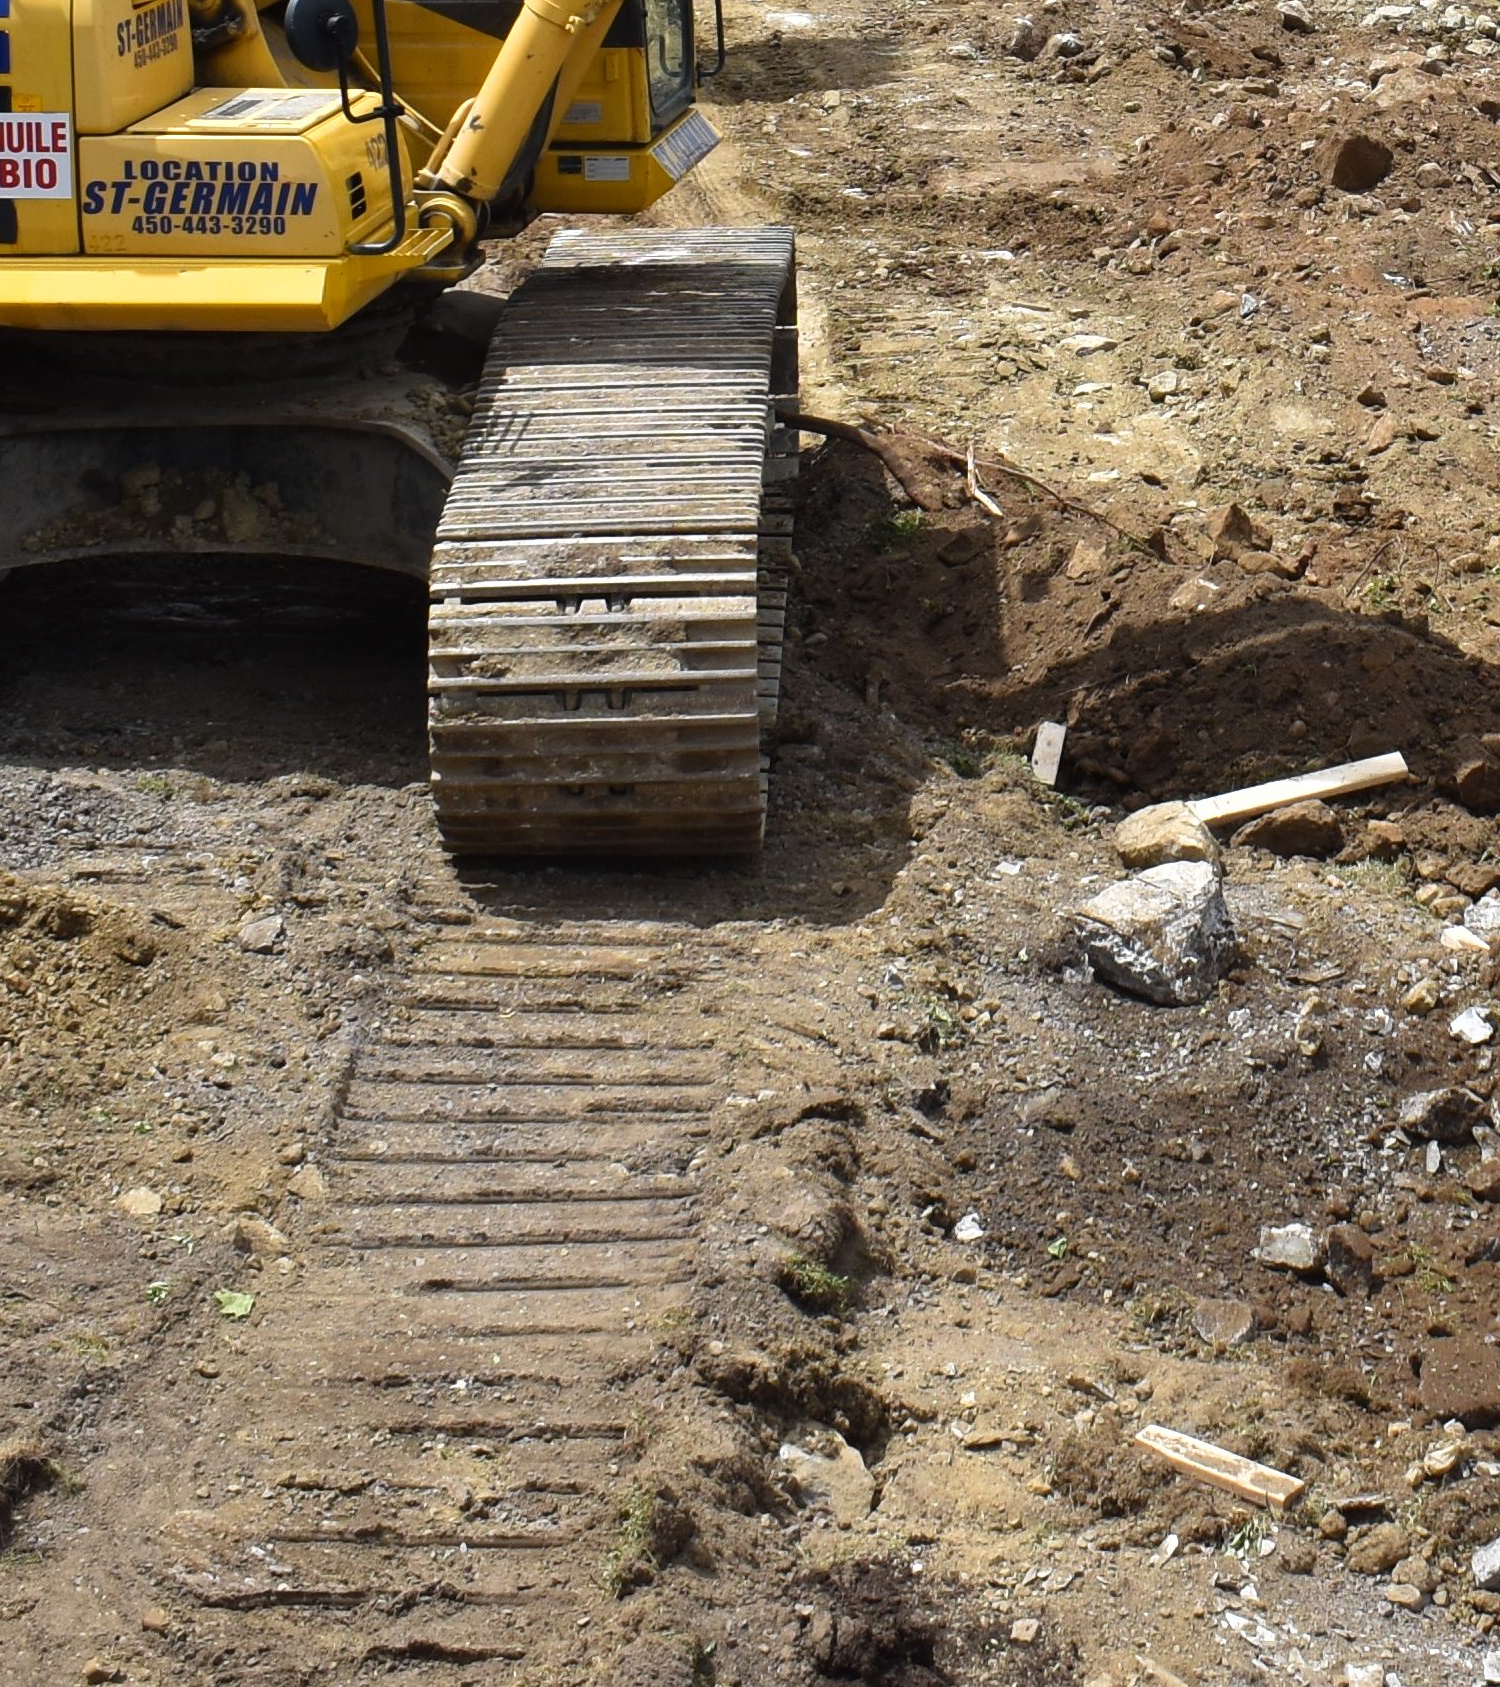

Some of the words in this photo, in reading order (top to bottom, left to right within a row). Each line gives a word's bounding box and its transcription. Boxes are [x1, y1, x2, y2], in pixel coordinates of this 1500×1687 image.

[123, 160, 279, 182] LOCATION
[82, 180, 319, 216] ST-GERMAIN
[131, 215, 286, 236] 450-443-3290
